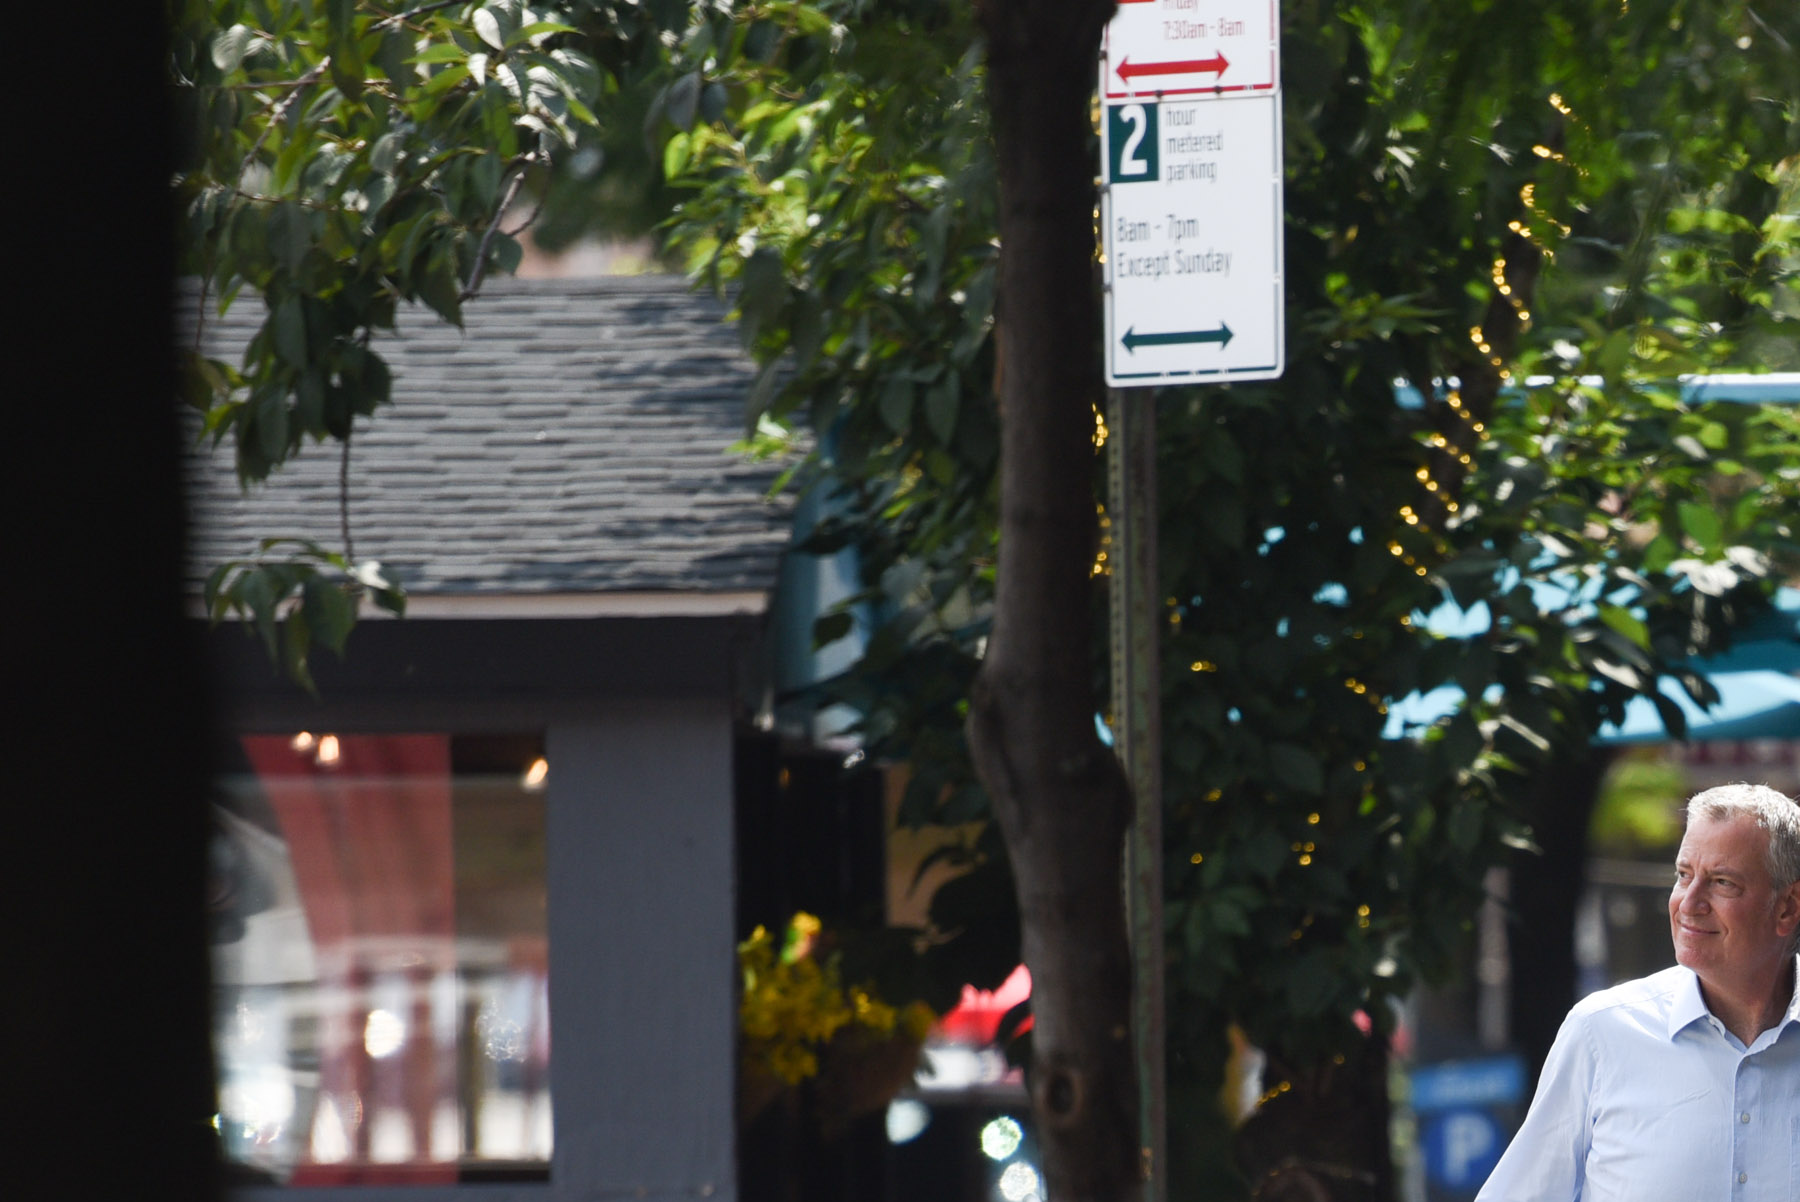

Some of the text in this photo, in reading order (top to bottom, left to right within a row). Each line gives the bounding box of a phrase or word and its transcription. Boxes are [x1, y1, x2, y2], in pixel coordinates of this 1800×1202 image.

[1217, 17, 1245, 37] 8am
[1166, 107, 1196, 127] hour
[1119, 105, 1148, 175] 2
[1166, 131, 1223, 153] metered
[1166, 160, 1217, 185] parking
[1117, 217, 1150, 242] 8am
[1166, 214, 1200, 244] 7pm
[1117, 249, 1233, 279] Except Sunday
[1444, 1112, 1492, 1184] P
